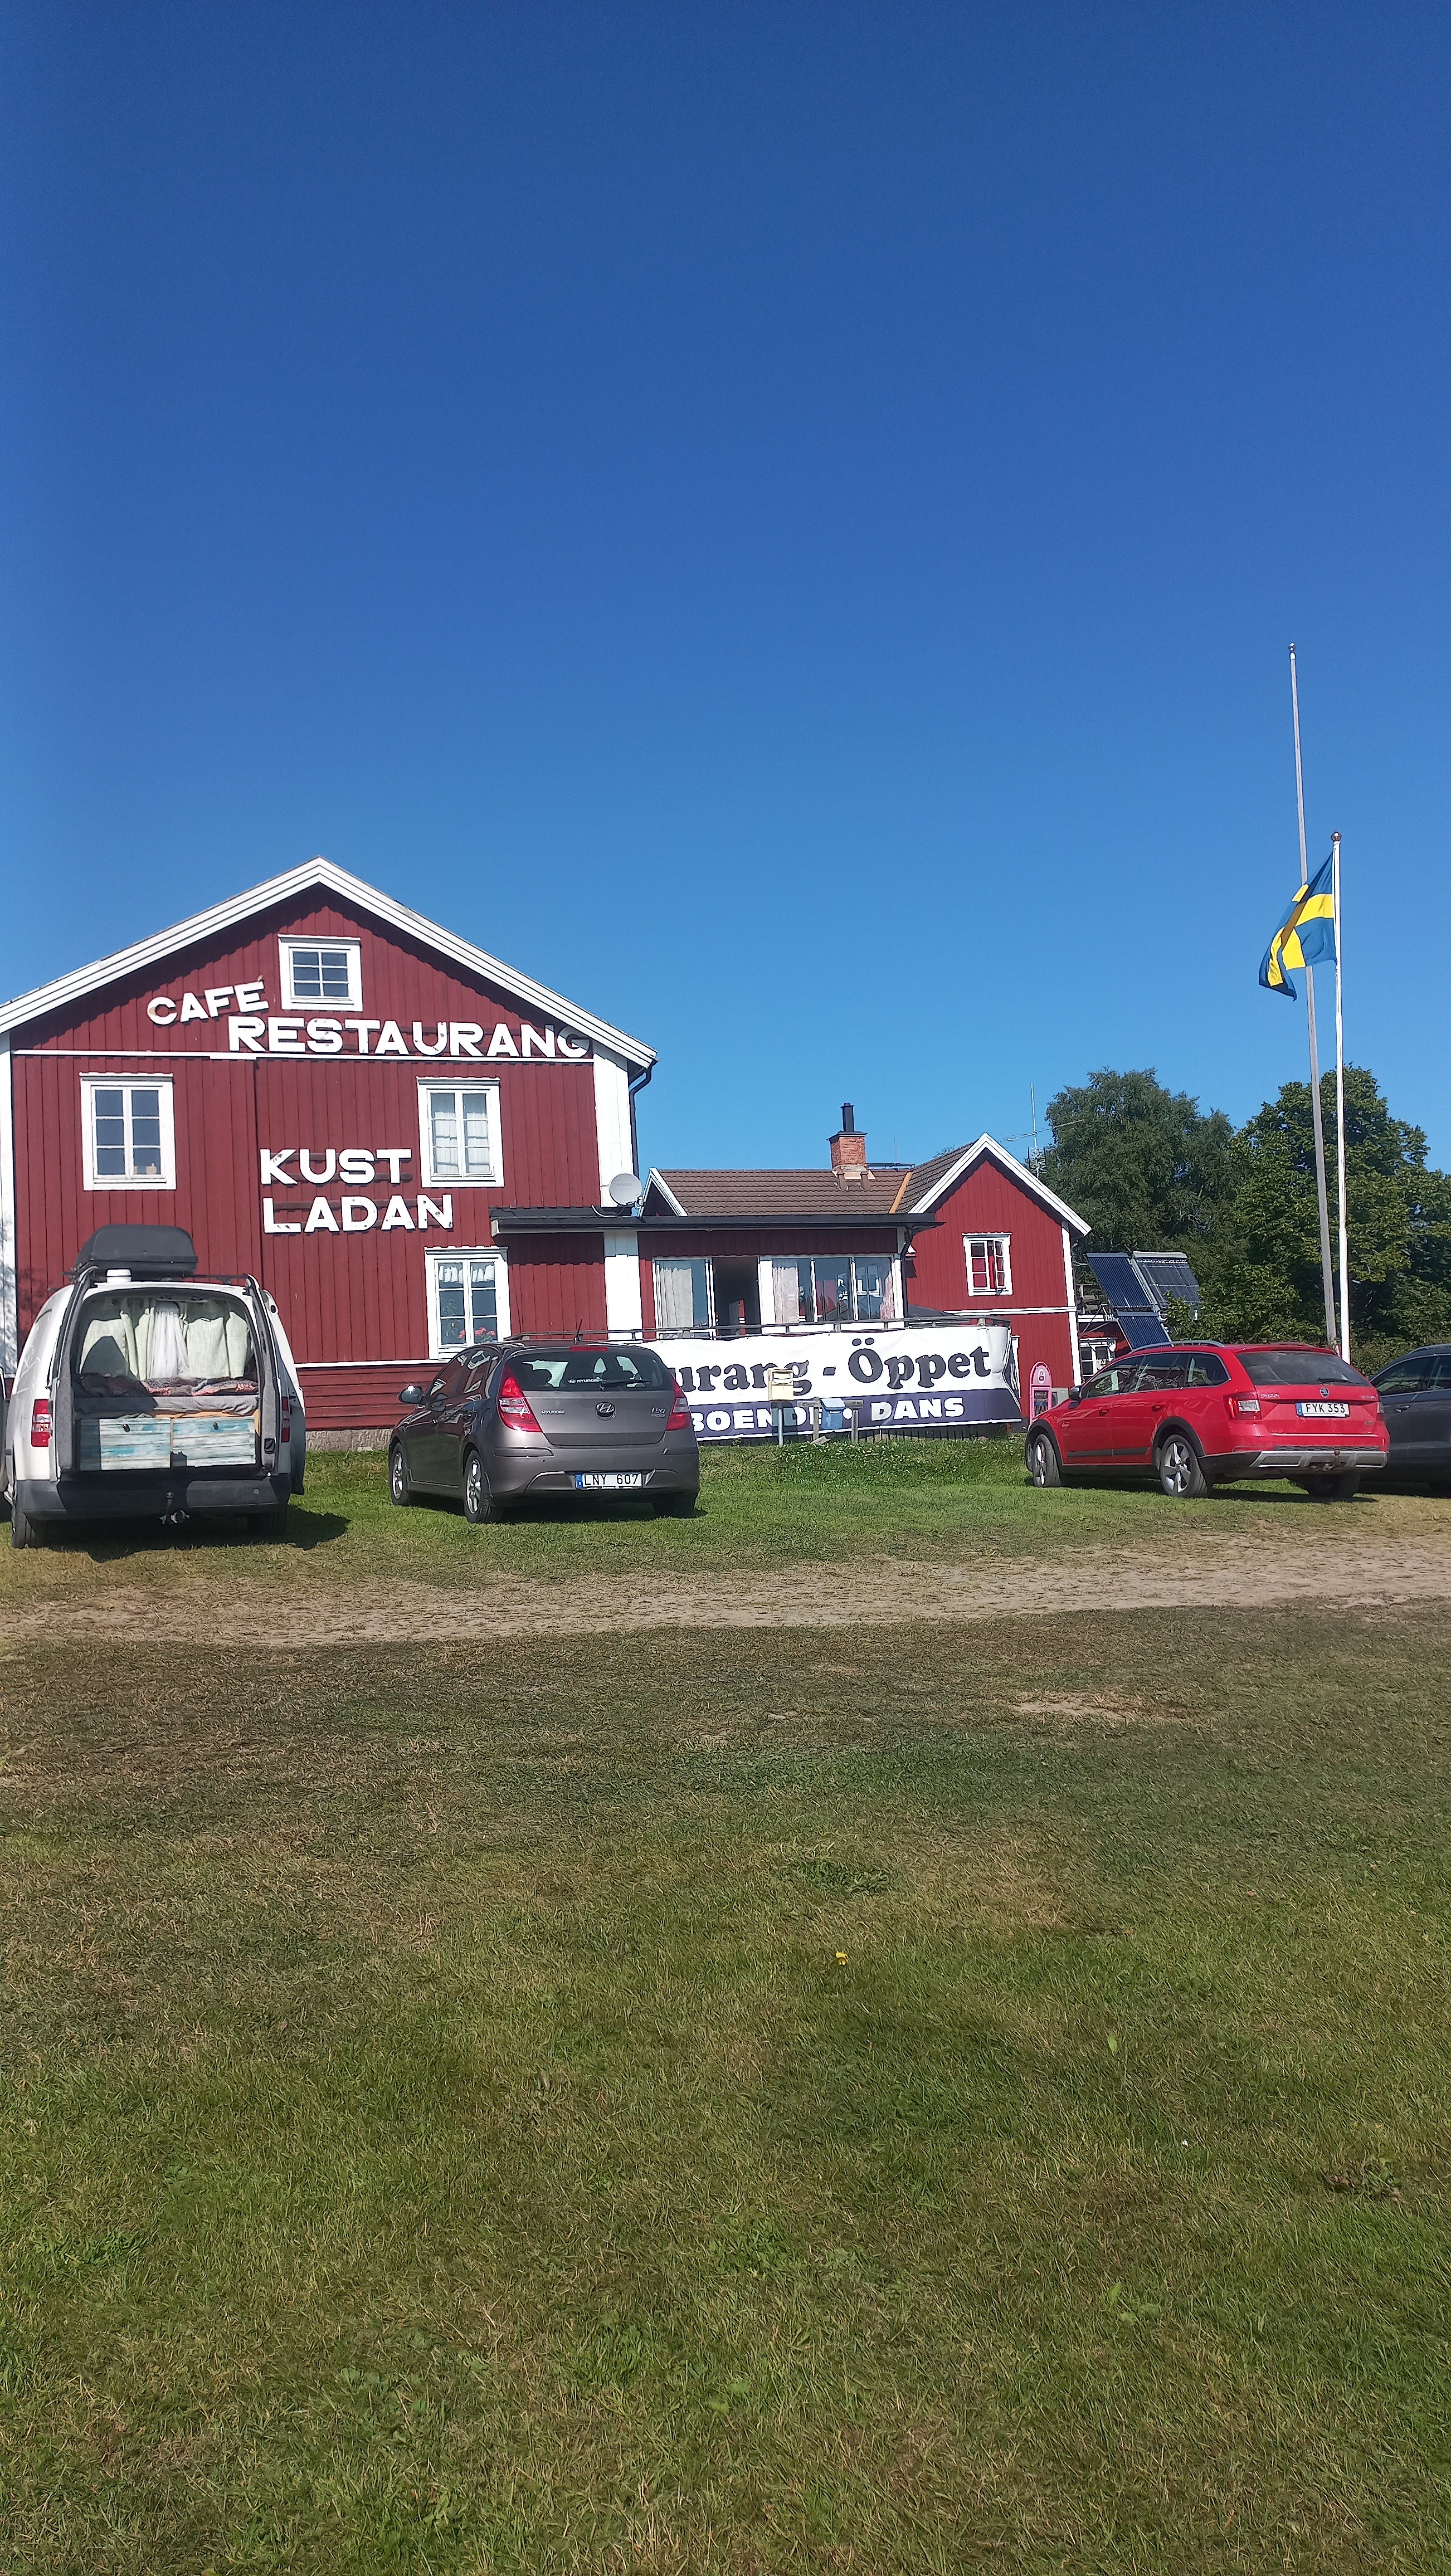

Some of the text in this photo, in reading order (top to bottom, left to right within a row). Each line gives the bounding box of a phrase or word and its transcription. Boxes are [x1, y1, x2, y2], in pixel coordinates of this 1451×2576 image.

[228, 1016, 591, 1058] RESTAURANG
[260, 1149, 412, 1184] KUST
[263, 1194, 453, 1233] LADAN
[848, 1337, 991, 1389] Öppet
[871, 1397, 965, 1421] DANS
[1306, 1403, 1345, 1413] FYK 353
[584, 1474, 639, 1485] LNY 607
